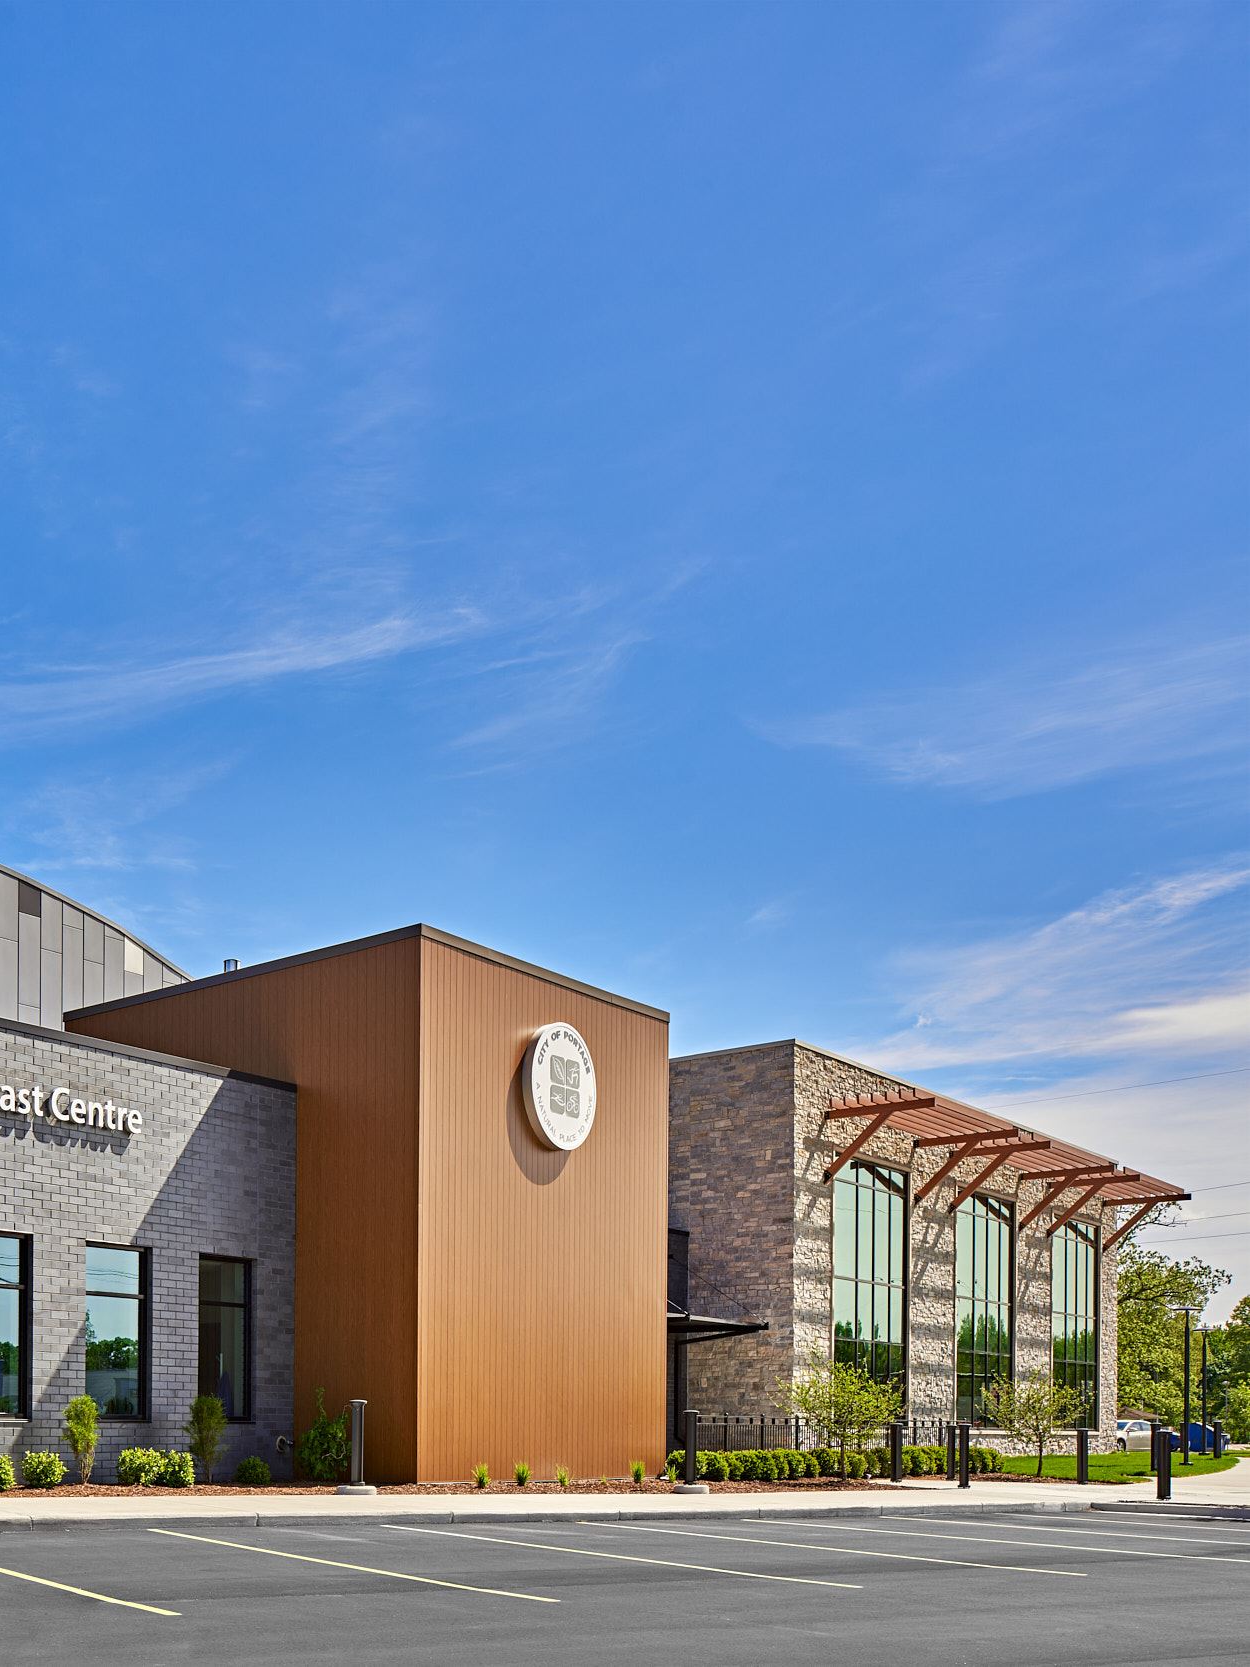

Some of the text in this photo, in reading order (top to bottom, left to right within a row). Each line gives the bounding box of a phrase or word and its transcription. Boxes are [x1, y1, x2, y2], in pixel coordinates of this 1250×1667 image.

[537, 1030, 591, 1075] CITY OF PORTAGE
[50, 1087, 142, 1133] Centre
[537, 1095, 556, 1137] NATURAL
[559, 1133, 576, 1143] PLACE
[577, 1125, 585, 1135] TO
